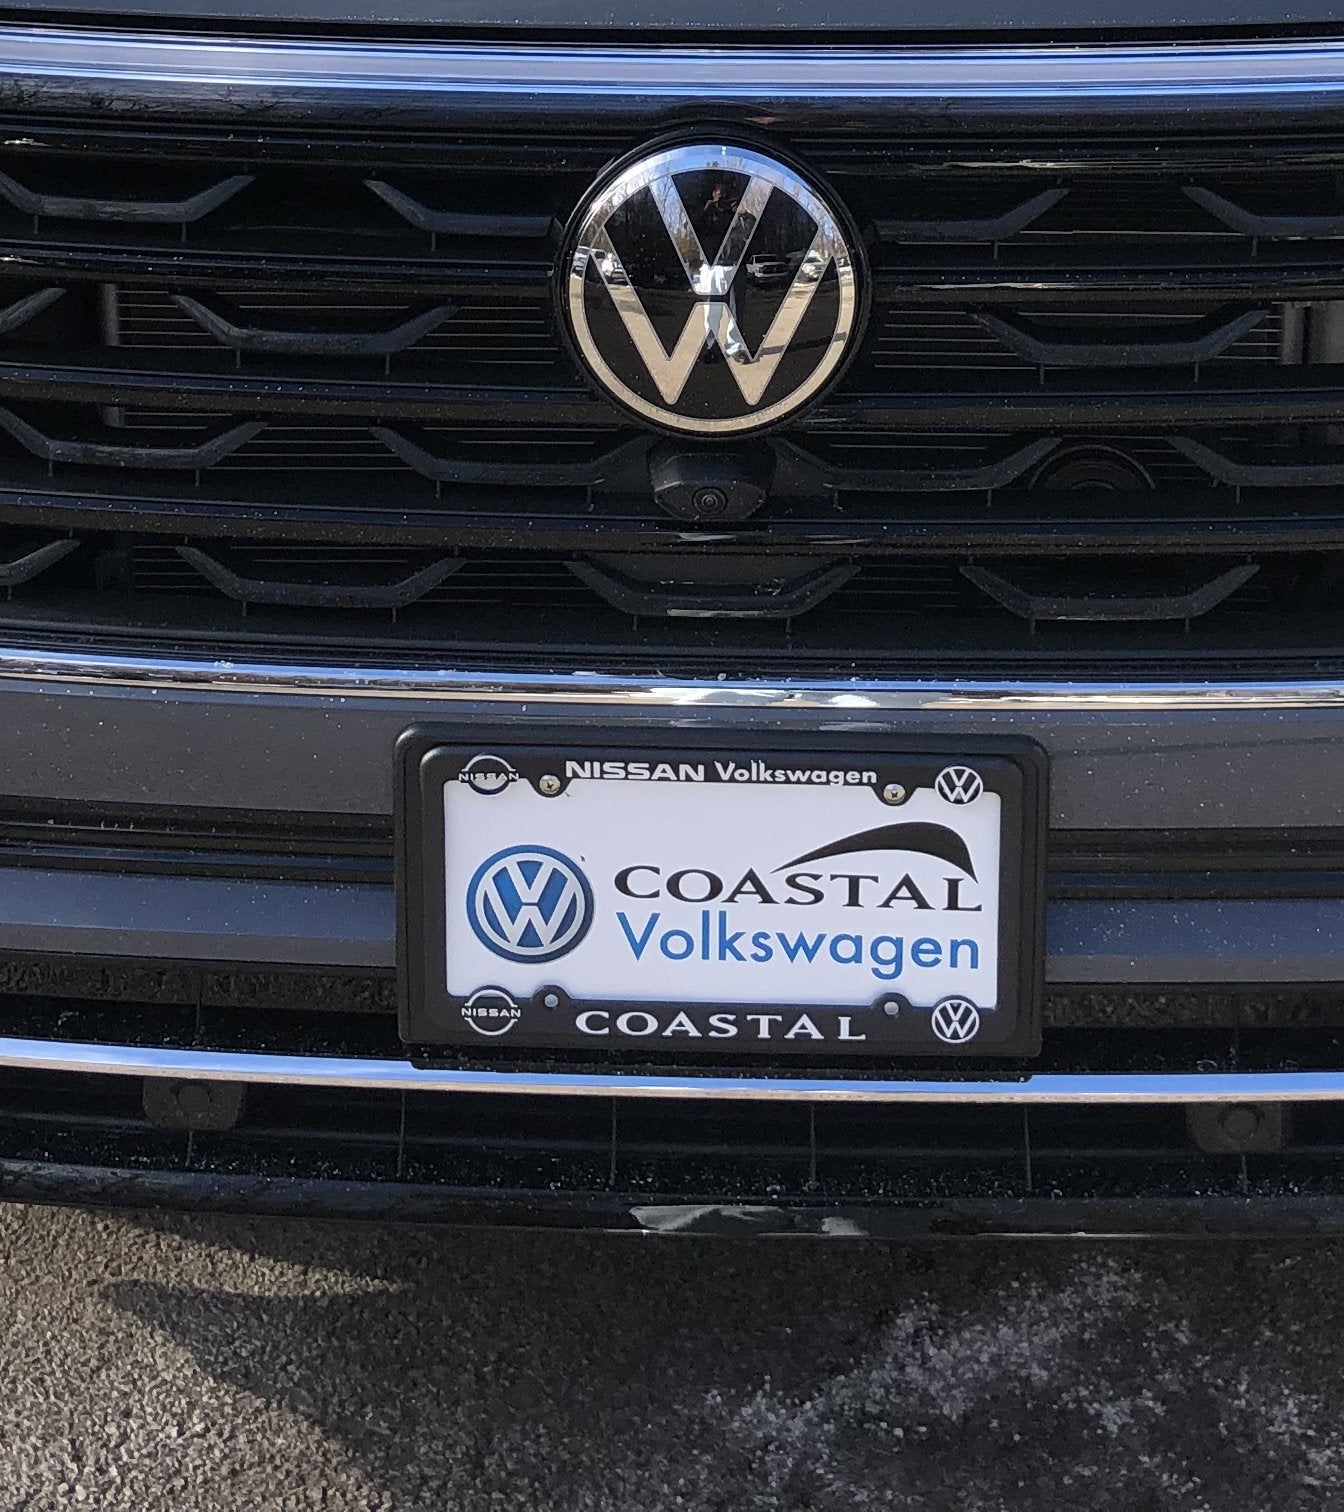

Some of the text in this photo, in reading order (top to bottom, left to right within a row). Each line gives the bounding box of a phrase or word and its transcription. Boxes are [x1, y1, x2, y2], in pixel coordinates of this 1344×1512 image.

[586, 166, 837, 409] VW
[458, 771, 520, 781] NISSAN
[565, 759, 878, 787] NISSAN Volkswagen
[937, 768, 982, 803] VW
[474, 852, 586, 956] VW
[613, 864, 983, 912] COASTAL
[615, 909, 980, 980] Volkswagen
[461, 1005, 522, 1020] NISSAN
[574, 1010, 867, 1041] COASTAL
[934, 997, 978, 1040] VW
